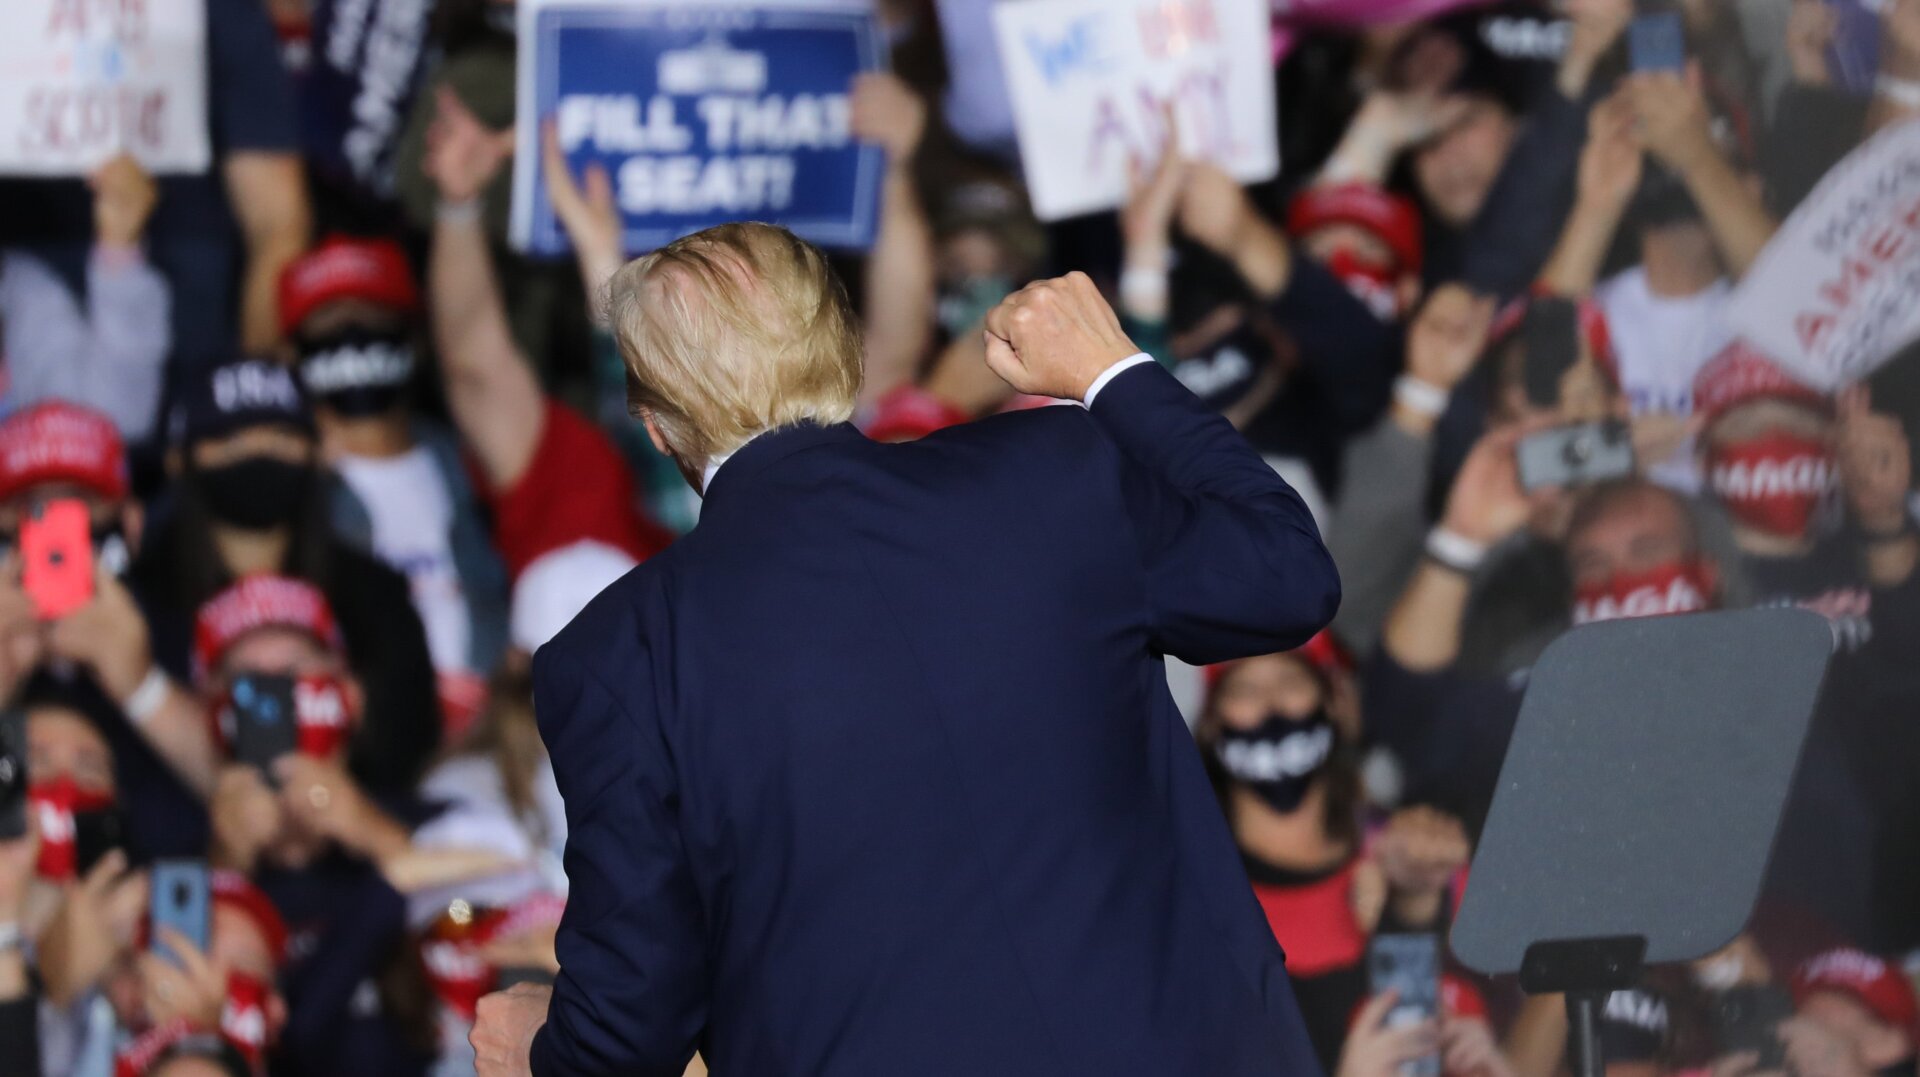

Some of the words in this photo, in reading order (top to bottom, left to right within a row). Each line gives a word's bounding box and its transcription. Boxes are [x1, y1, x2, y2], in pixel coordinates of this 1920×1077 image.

[557, 92, 692, 153] FILL
[697, 91, 851, 149] THAT
[617, 154, 795, 214] SEAT!
